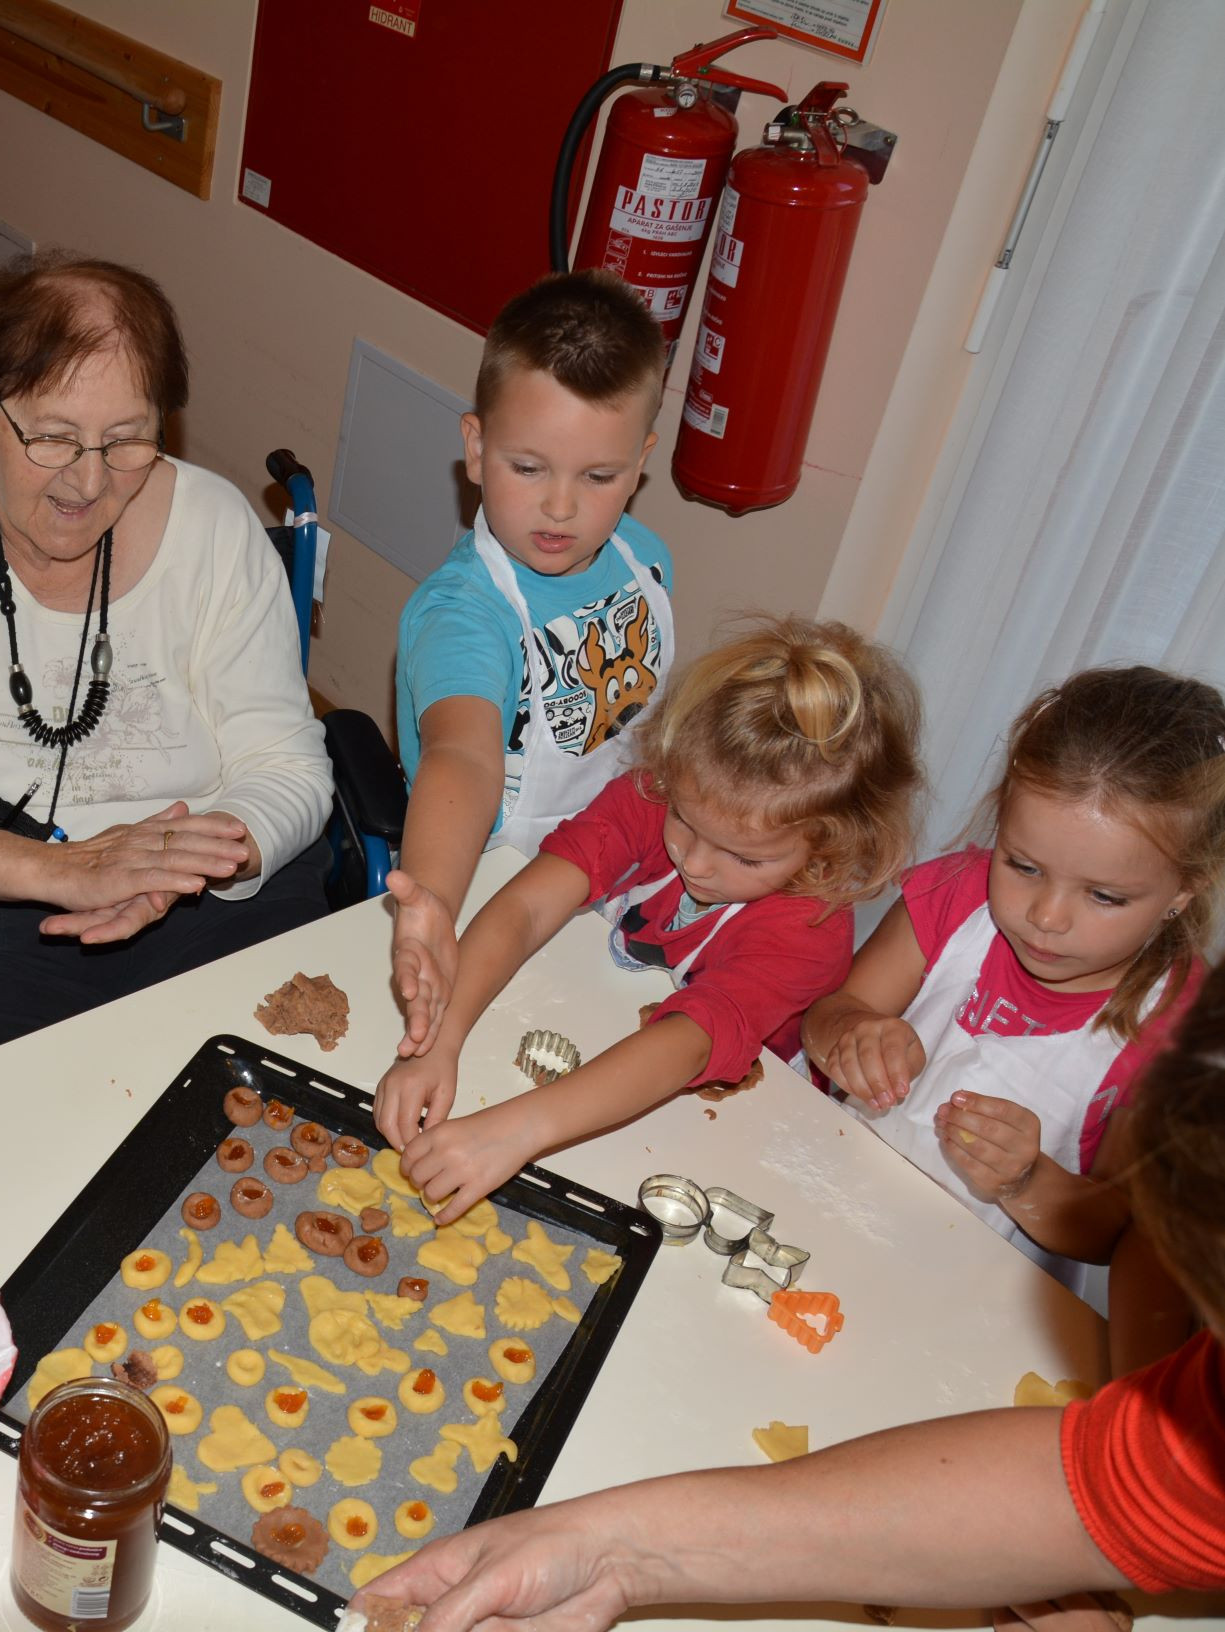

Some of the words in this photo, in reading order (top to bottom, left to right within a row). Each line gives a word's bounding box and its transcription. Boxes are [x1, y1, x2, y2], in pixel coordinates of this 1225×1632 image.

[371, 8, 413, 34] HIDRANT
[621, 189, 706, 221] PASTOR
[627, 217, 654, 229] APARAT
